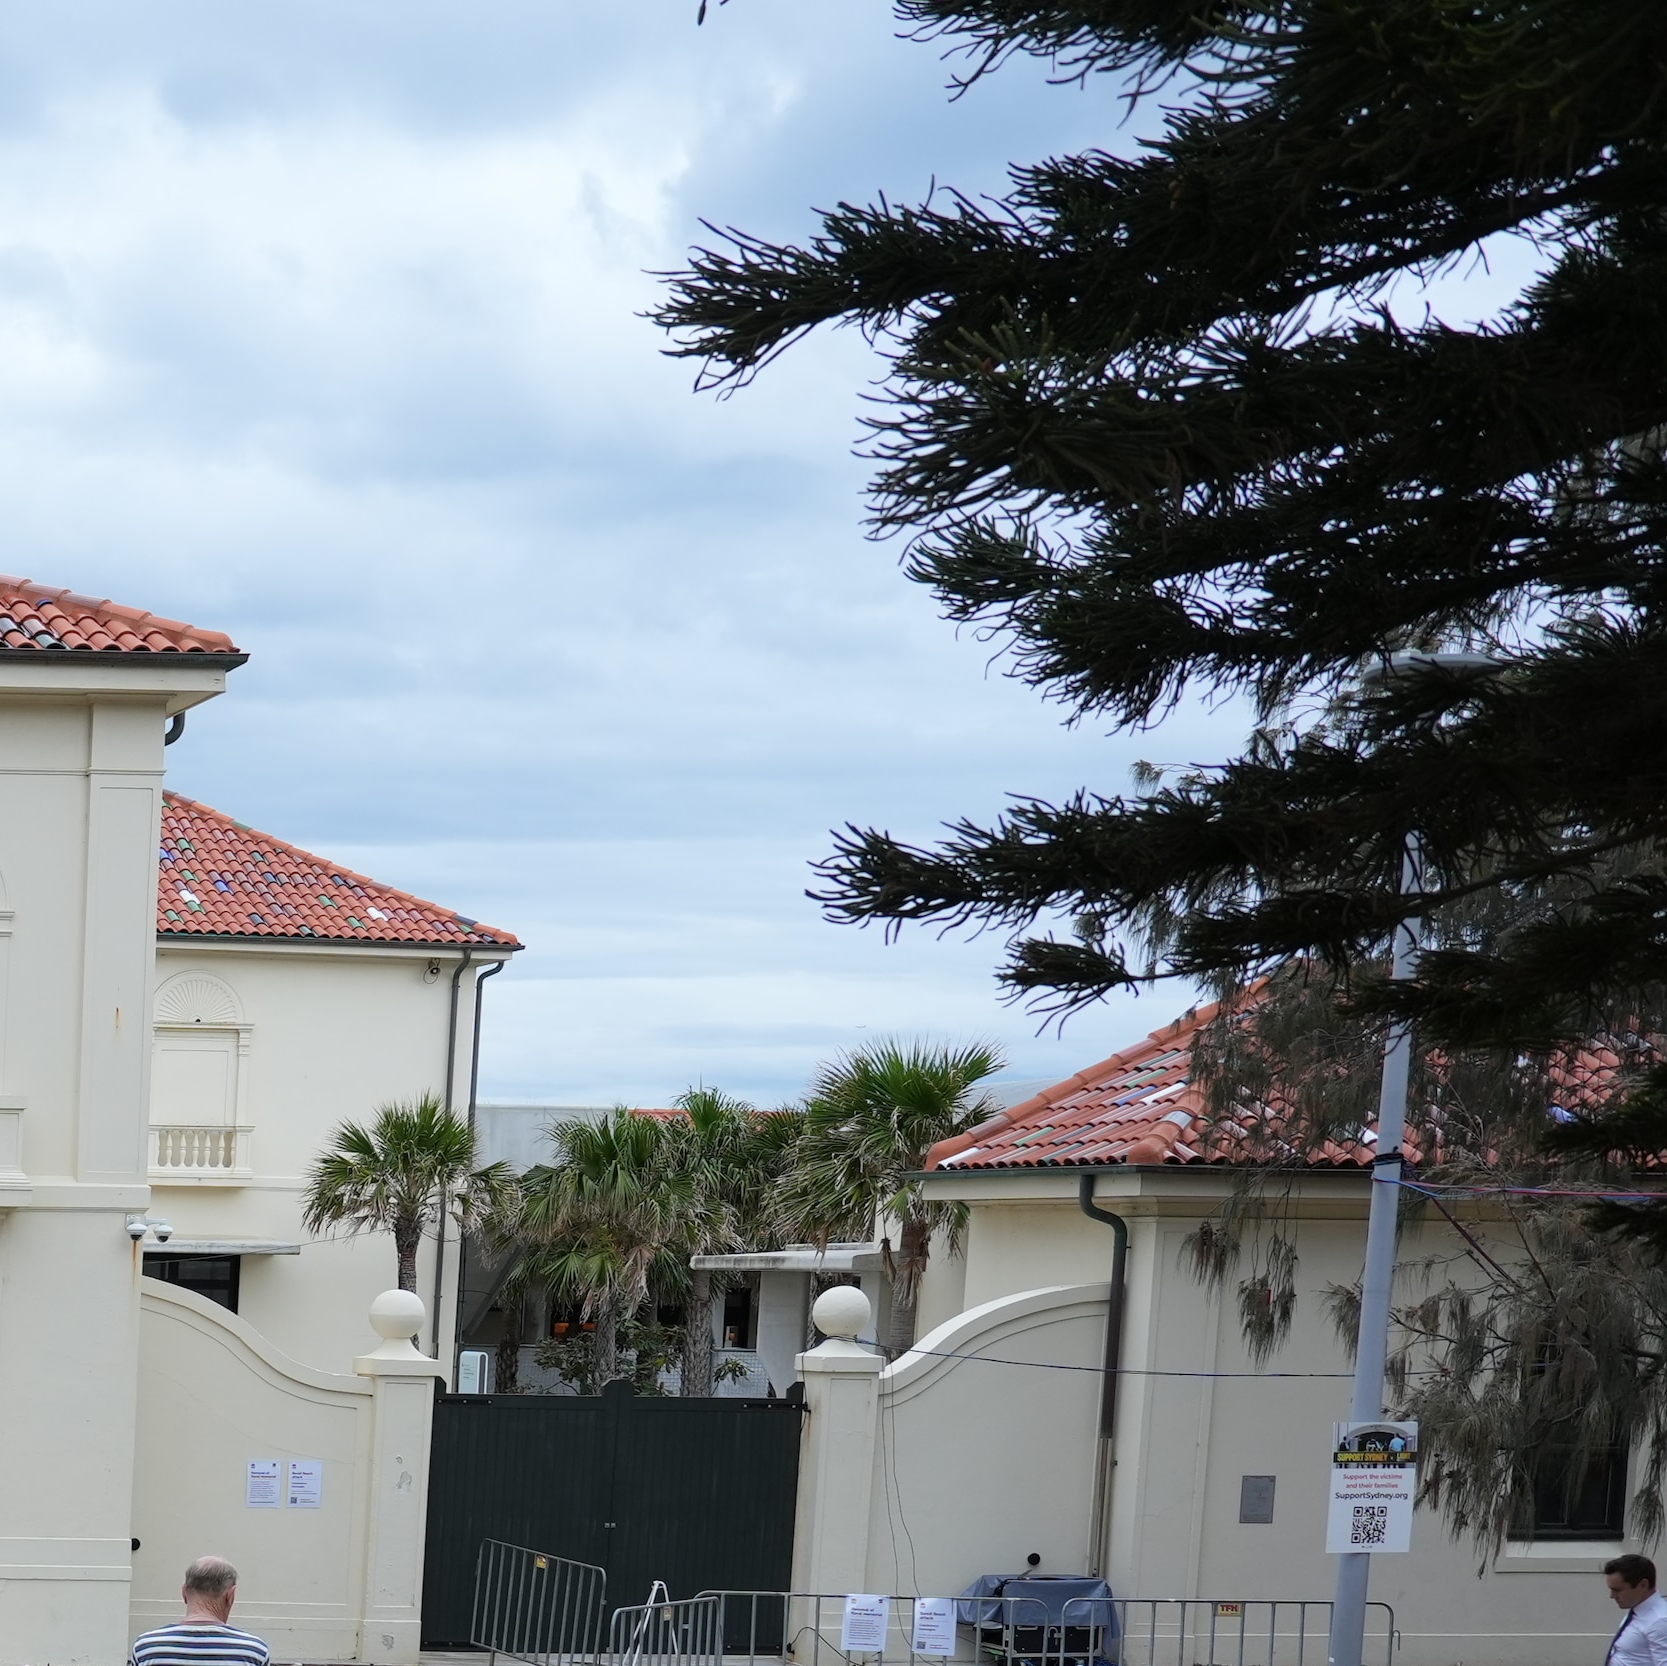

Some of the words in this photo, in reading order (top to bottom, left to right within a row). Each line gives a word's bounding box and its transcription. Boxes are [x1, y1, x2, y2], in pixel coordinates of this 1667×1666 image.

[1337, 1453, 1364, 1461] SUPPORT
[1365, 1453, 1388, 1461] SYDNEY
[1335, 1492, 1408, 1500] SupportSydney.org
